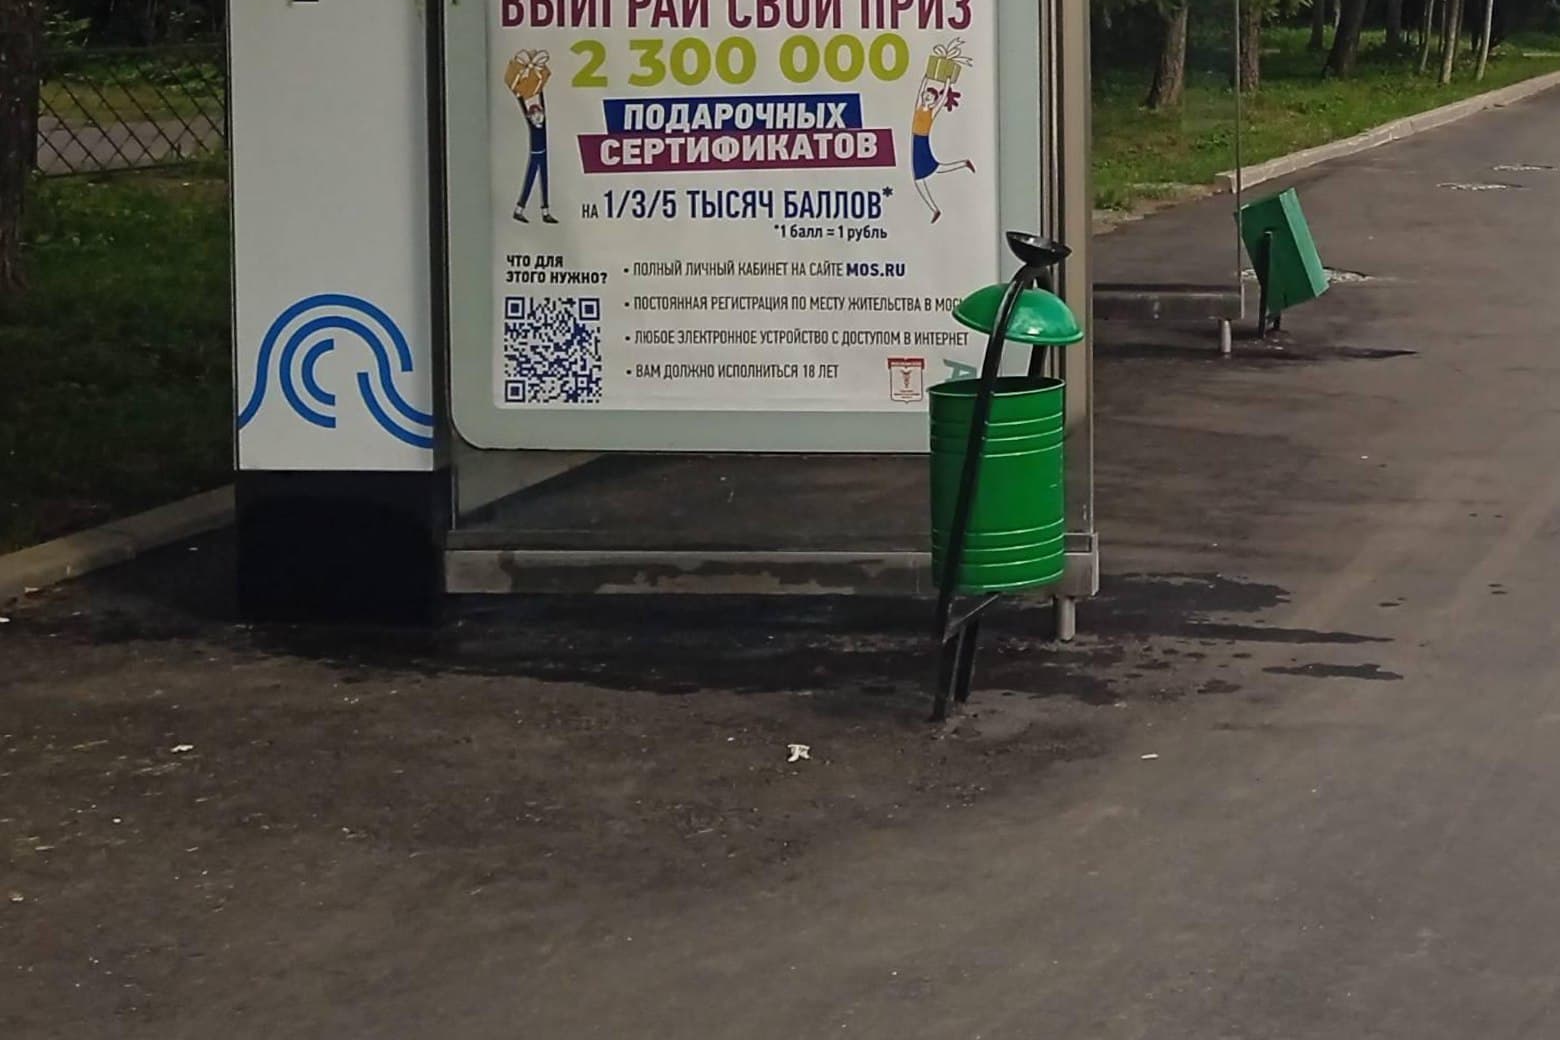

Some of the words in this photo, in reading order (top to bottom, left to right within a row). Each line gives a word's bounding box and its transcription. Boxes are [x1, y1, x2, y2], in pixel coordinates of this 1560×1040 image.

[570, 39, 608, 89] 2
[627, 35, 757, 88] 300
[779, 32, 911, 84] 000
[623, 102, 849, 133] ПОДАРОЧНЫХ
[599, 132, 879, 166] СЕРТИФИКАТОВ
[582, 203, 599, 219] НА
[603, 190, 677, 219] 1/3/5
[686, 190, 774, 219] ТЫСЯЧ
[790, 224, 823, 239] балл
[847, 225, 888, 241] рубль
[507, 255, 531, 268] ЧТО
[534, 255, 564, 269] ДЛЯ
[633, 261, 682, 276] ПОЛНЫЙ
[685, 261, 733, 276] ЛИЧНЫЙ
[738, 262, 788, 276] КАБИНЕТ
[792, 263, 806, 276] НА
[810, 261, 843, 276] САЙТЕ
[846, 263, 905, 277] MOS.RU
[506, 271, 546, 284] ЭТОГО
[550, 271, 608, 285] НУЖНО?
[634, 296, 707, 310] ПОСТОЯННАЯ
[711, 296, 789, 312] РЕГИСТРАЦИЯ
[792, 297, 806, 310] ПО
[810, 297, 845, 311] МЕСТУ
[848, 297, 921, 312] ЖИТЕЛЬСТВА
[925, 298, 932, 312] В
[635, 330, 675, 345] ЛЮБОЕ
[678, 331, 757, 345] ЭЛЕКТРОННОЕ
[760, 328, 829, 345] УСТРОЙСТВО
[832, 332, 839, 345] С
[841, 332, 901, 347] ДОСТУПОМ
[904, 332, 911, 346] В
[915, 332, 969, 347] ИНТЕРНЕТ
[636, 364, 661, 379] ВАМ
[664, 364, 715, 380] ДОЛЖНО
[718, 364, 798, 379] ИСПОЛНИТЬСЯ
[803, 364, 815, 378] 18
[818, 364, 839, 379] ЛЕТ
